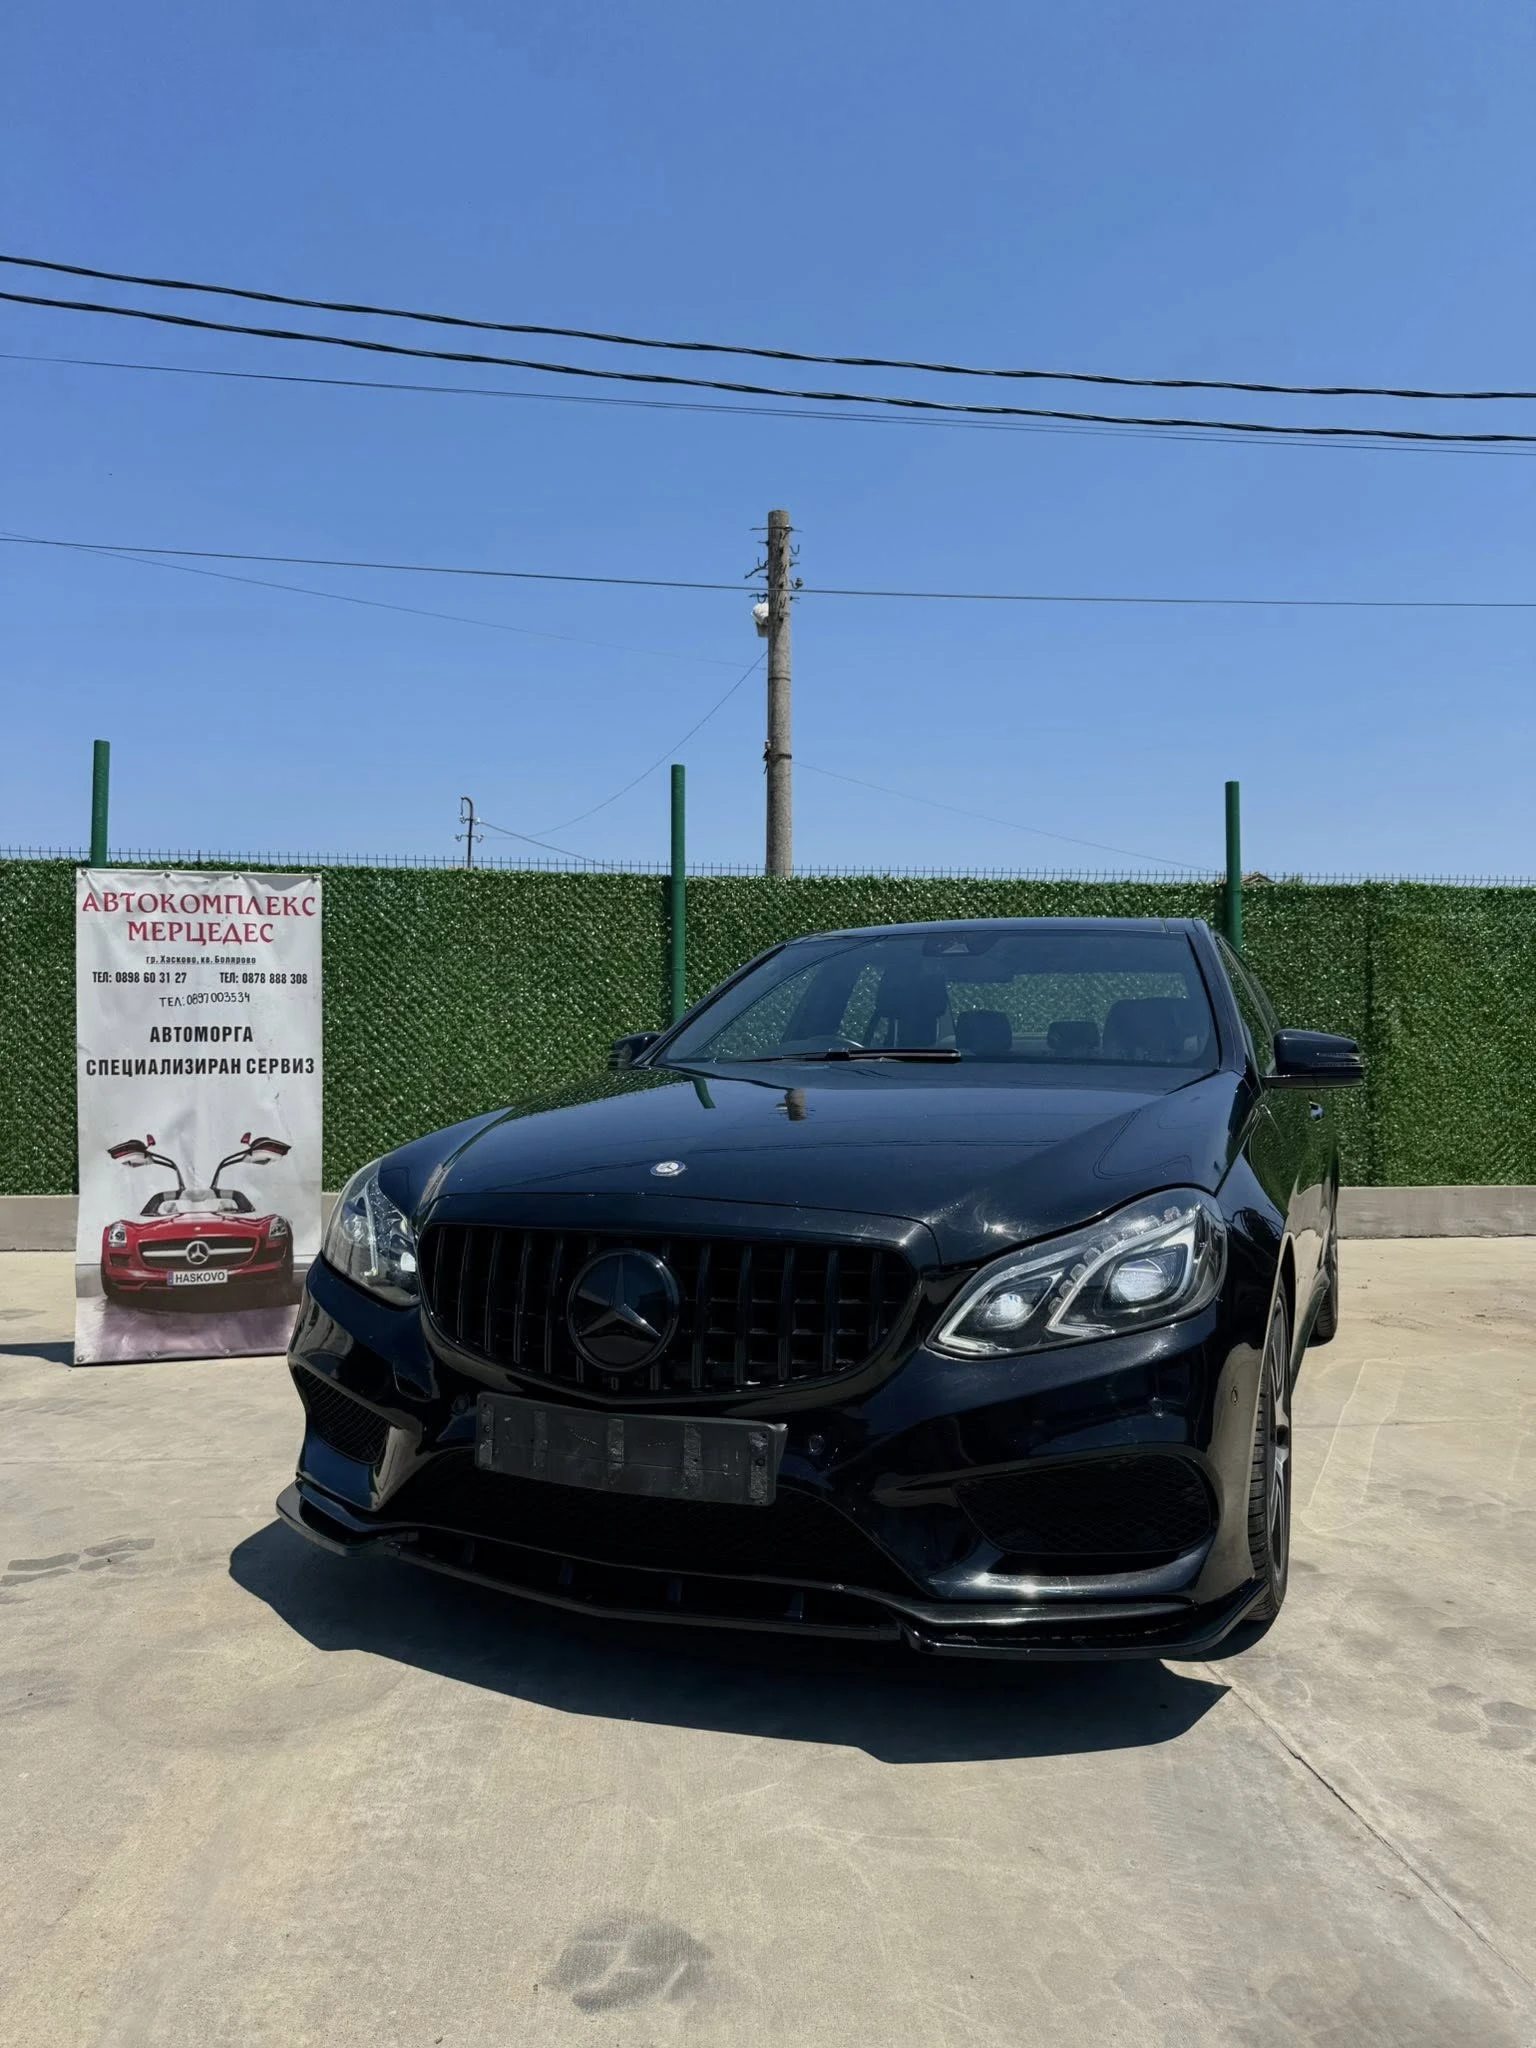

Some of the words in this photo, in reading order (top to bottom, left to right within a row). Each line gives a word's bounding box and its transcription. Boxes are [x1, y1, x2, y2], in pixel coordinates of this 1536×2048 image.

[82, 892, 316, 916] АВТОКОМПЛЕКС
[128, 921, 274, 946] МЕРЦЕДЕС
[92, 971, 112, 983] ТЕЛ:
[115, 971, 140, 983] 0898
[143, 971, 156, 984] 60
[159, 972, 170, 984] 31
[174, 972, 187, 984] 27
[219, 972, 239, 984] ТЕЛ:
[242, 972, 266, 984] 0878
[269, 973, 287, 984] 888
[290, 973, 308, 985] 308
[150, 1026, 253, 1043] АВТОМОРГА
[86, 1058, 241, 1077] СПЕЦИАЛИЗИРАН
[246, 1058, 315, 1075] СЕРВИЗ
[175, 1271, 225, 1283] HASKOVO
